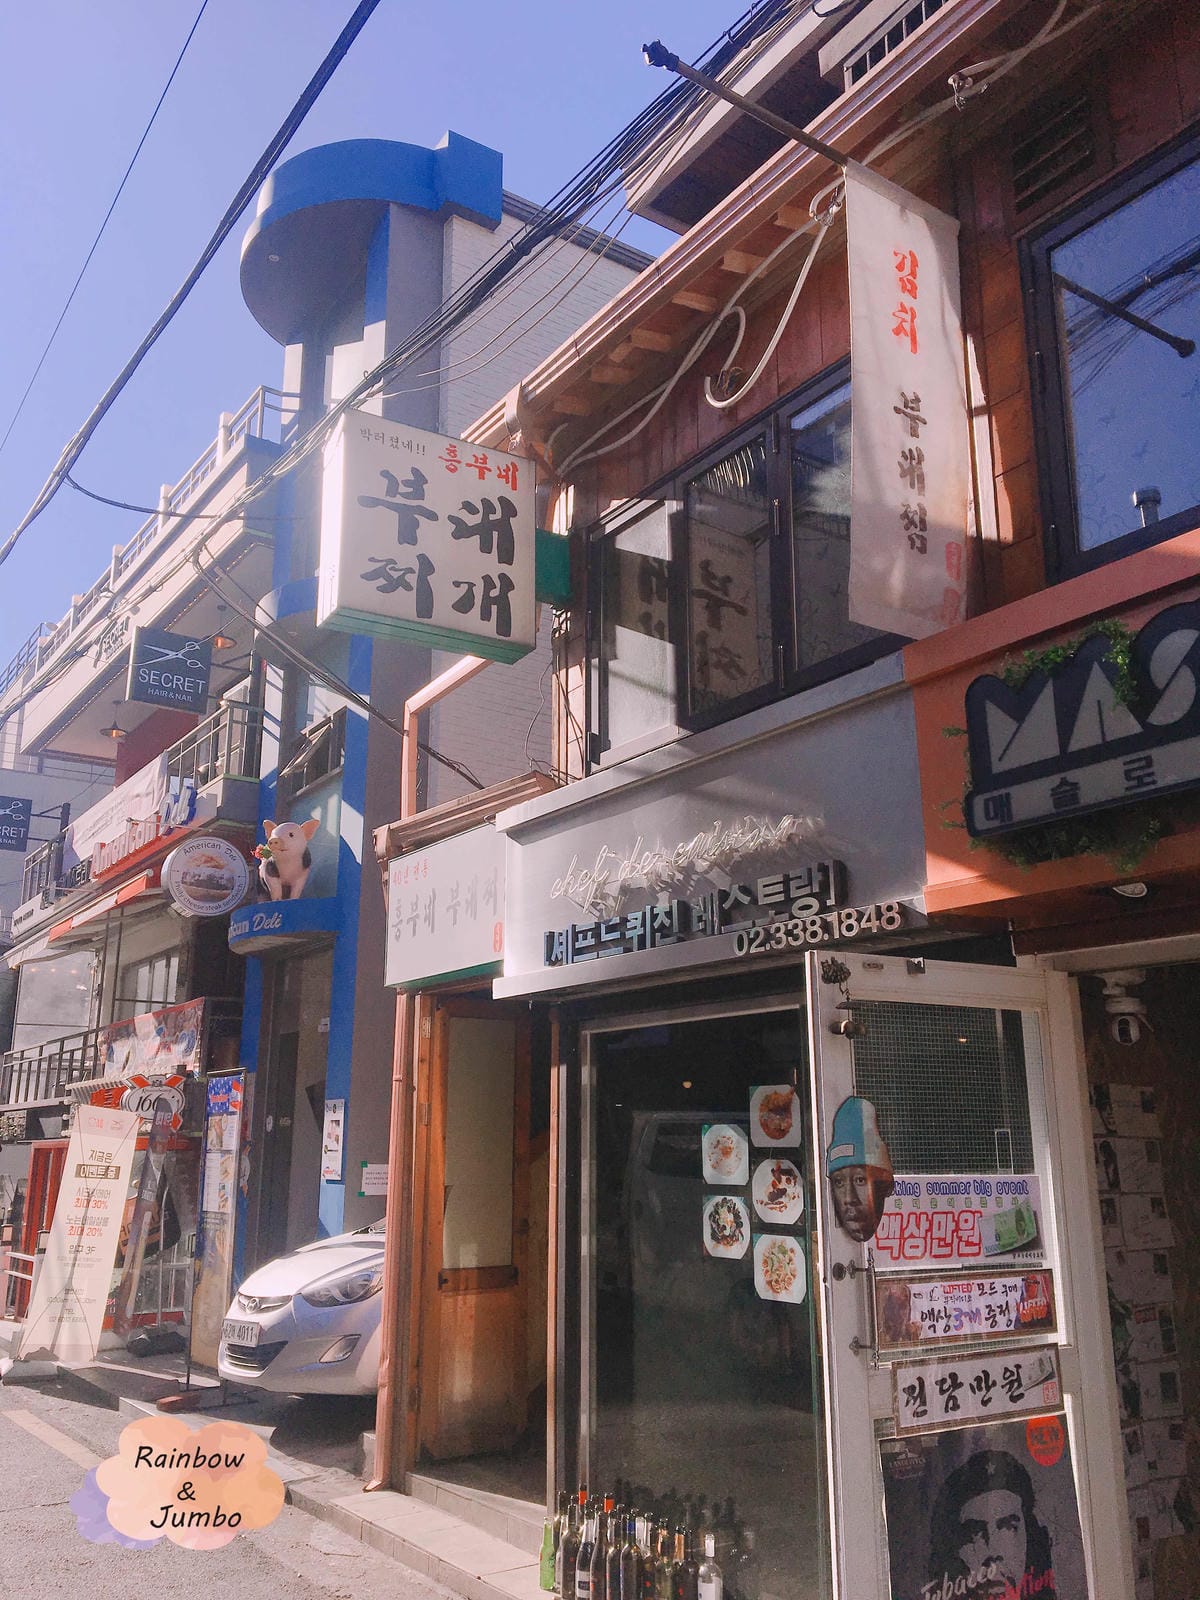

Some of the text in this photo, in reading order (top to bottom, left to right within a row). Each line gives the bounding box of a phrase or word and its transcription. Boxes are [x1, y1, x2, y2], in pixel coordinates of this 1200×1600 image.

[892, 249, 919, 355] 김치
[438, 443, 519, 491] 흥부네
[357, 466, 518, 566] 부대
[359, 553, 515, 638] 찌개
[138, 668, 206, 695] SECRET
[0, 826, 27, 838] RET
[183, 841, 237, 862] American Deli
[252, 911, 283, 931] Deli
[732, 901, 903, 957] 02.338.1848
[89, 1149, 113, 1164] 지금은
[895, 1179, 1029, 1197] king summer big event
[977, 1281, 997, 1297] 모드
[984, 1300, 1012, 1329] 증정
